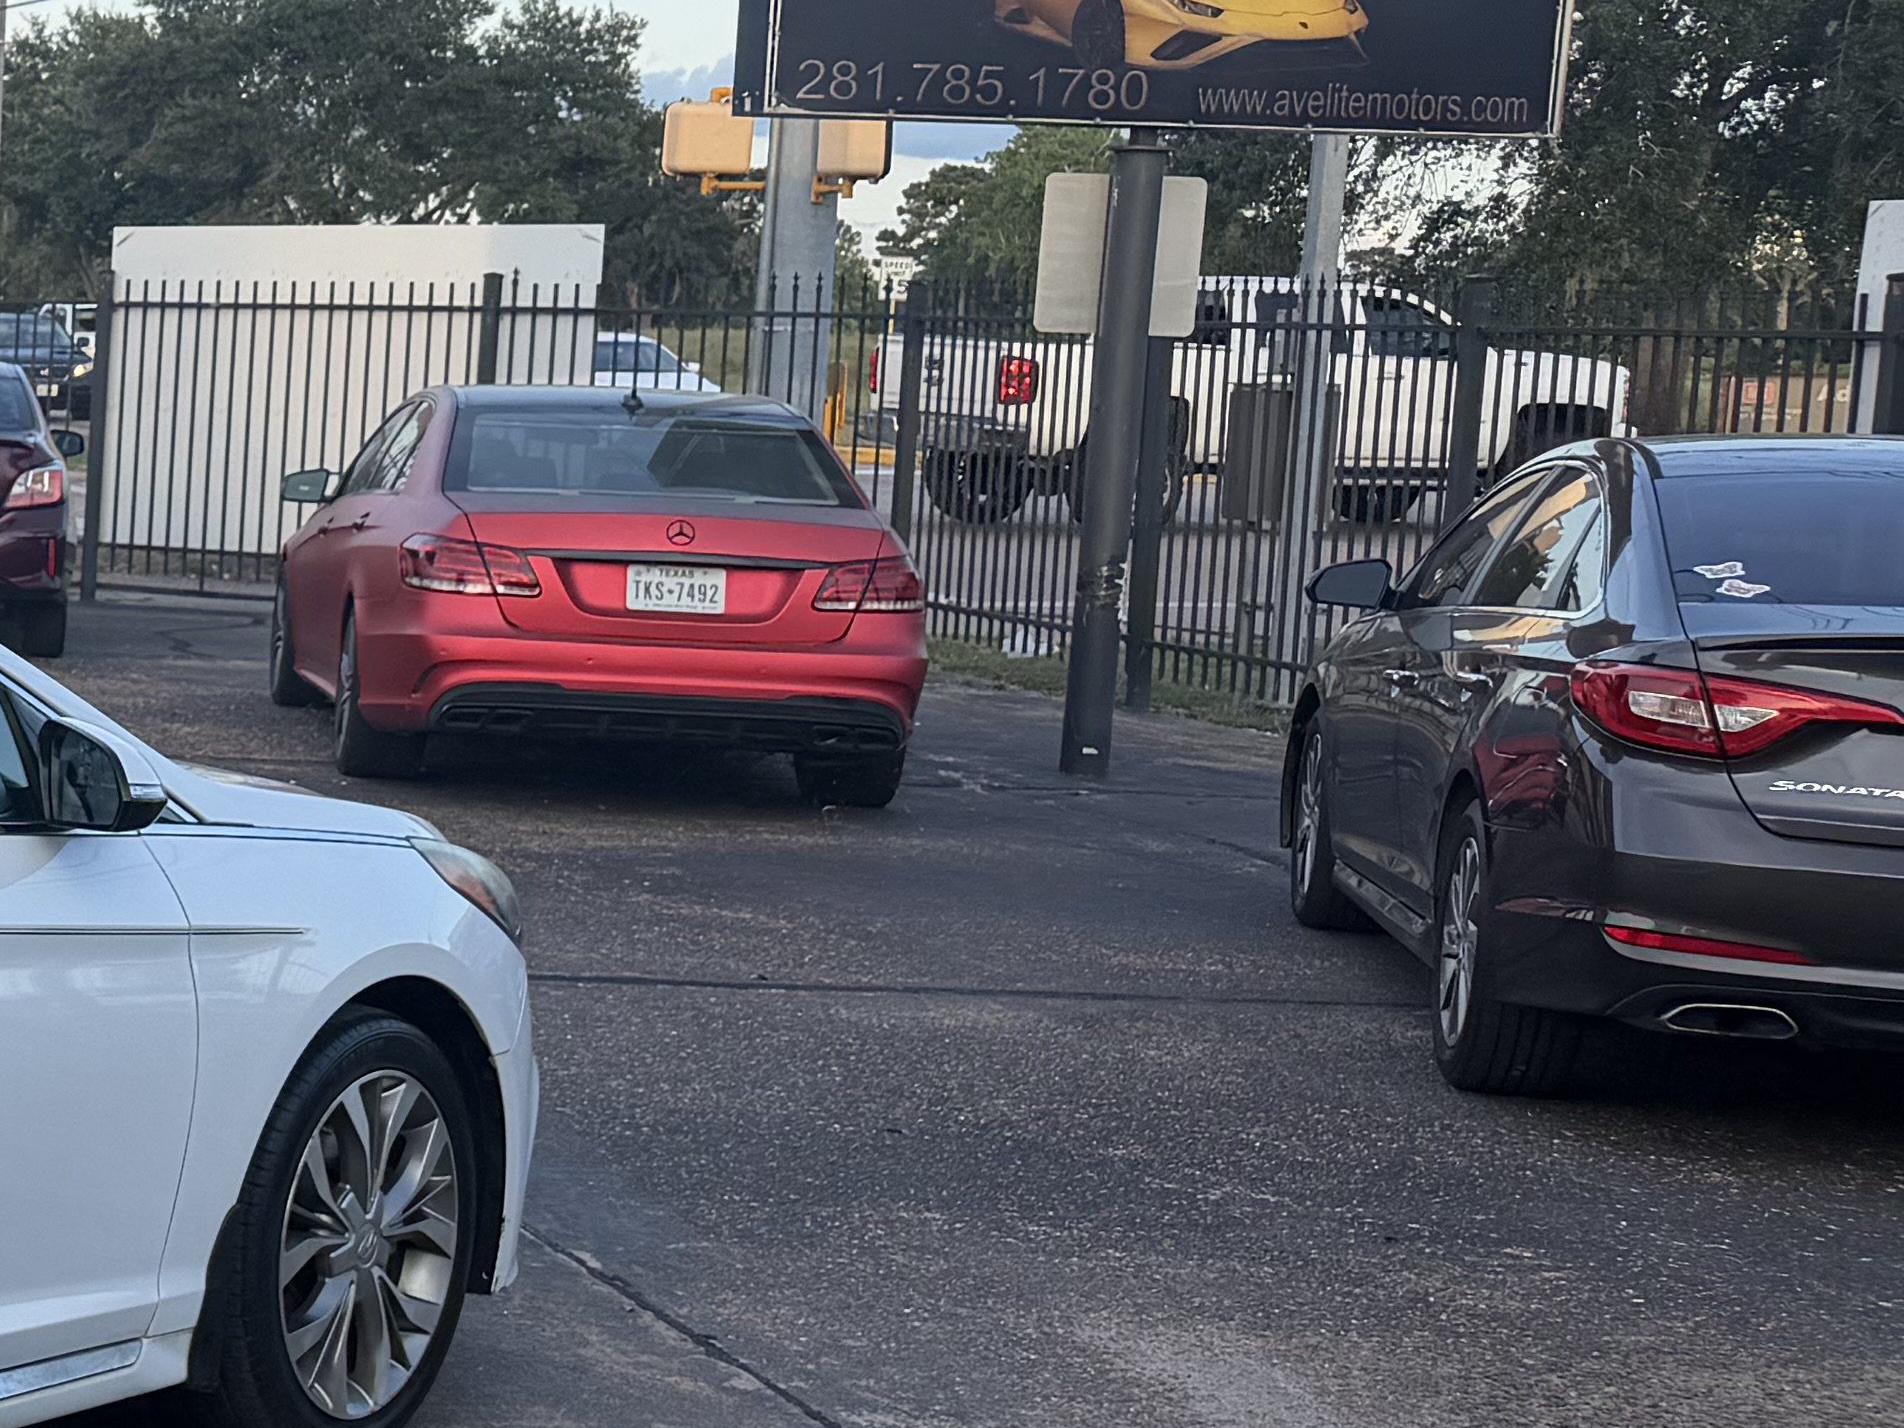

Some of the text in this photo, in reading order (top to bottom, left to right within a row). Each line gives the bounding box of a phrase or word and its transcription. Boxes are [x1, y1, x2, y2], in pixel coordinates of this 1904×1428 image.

[795, 58, 1149, 111] 281.785.1780
[1198, 83, 1528, 122] www.avelitemotors.com
[659, 567, 695, 579] TEXAS
[1768, 780, 1904, 800] SONATA
